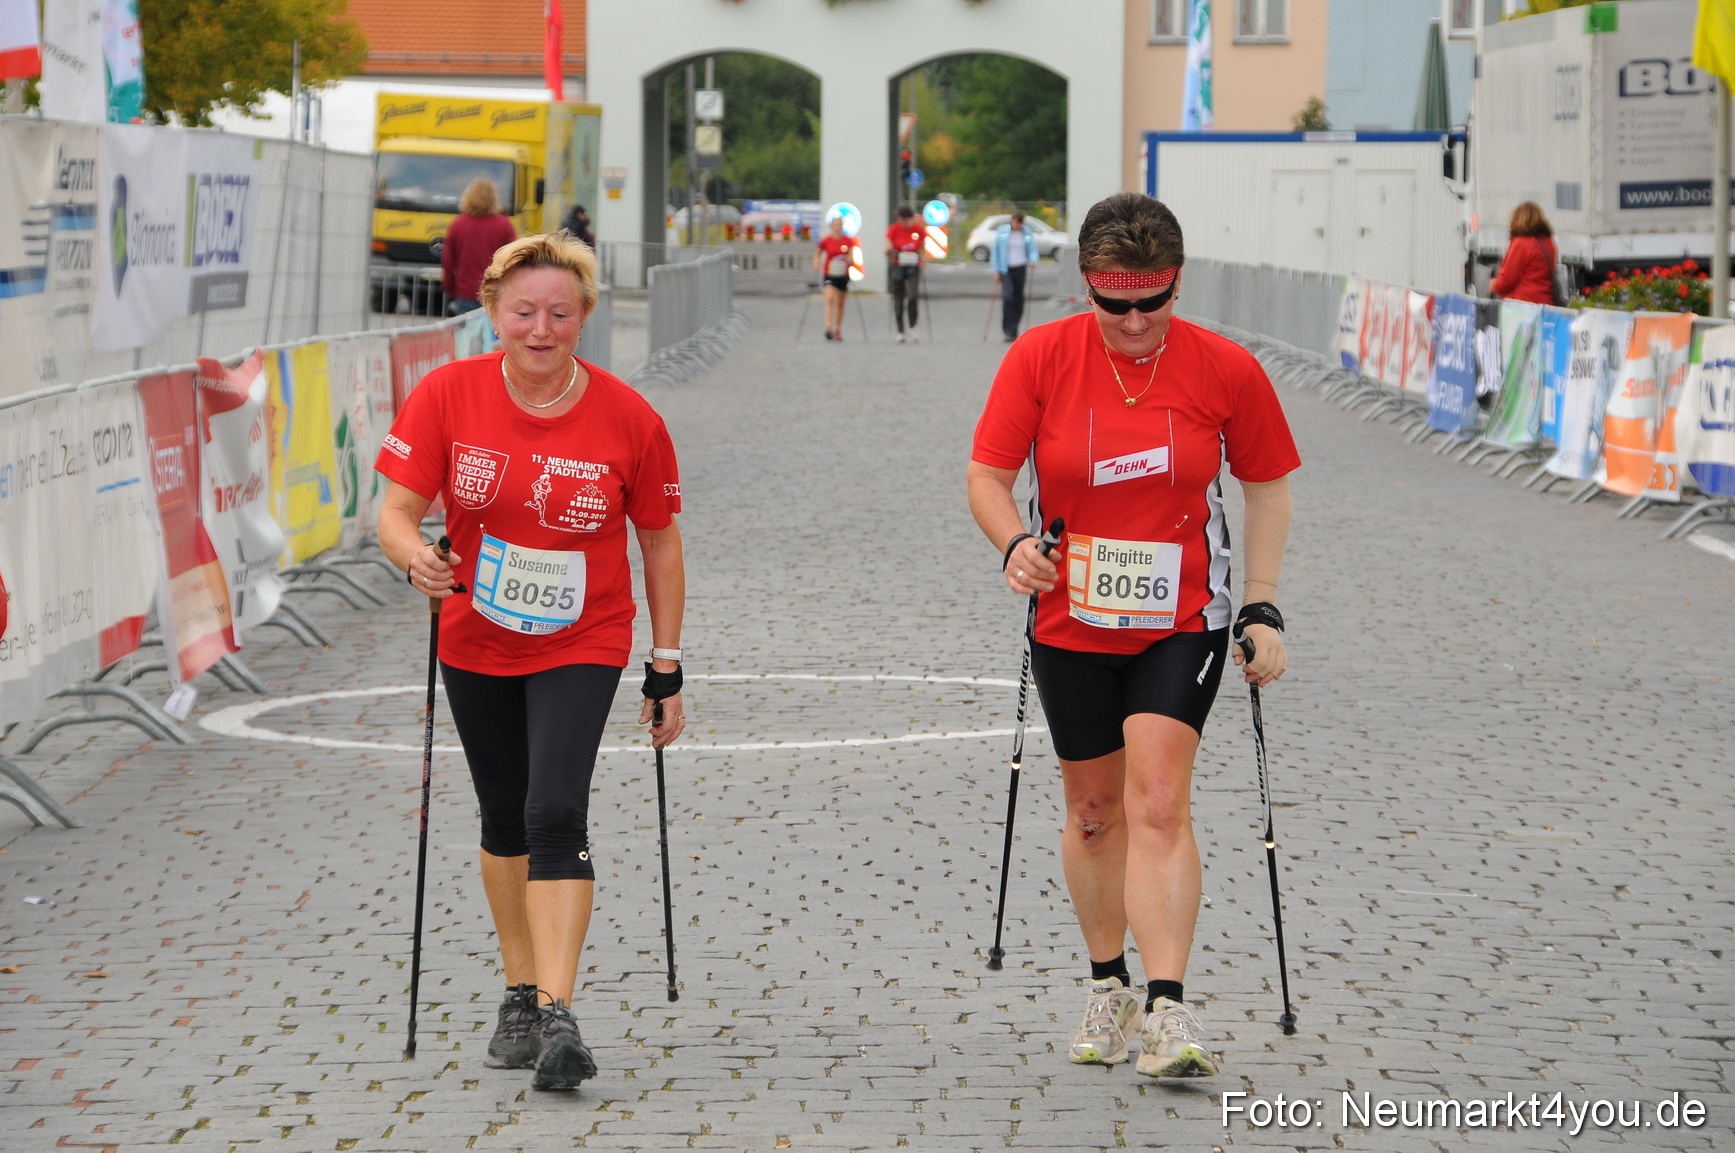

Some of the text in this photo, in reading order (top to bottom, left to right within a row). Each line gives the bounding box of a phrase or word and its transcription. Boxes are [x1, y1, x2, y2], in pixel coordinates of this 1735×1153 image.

[1619, 58, 1716, 97] BO
[1626, 186, 1712, 204] www.boc
[457, 453, 497, 470] IMMER
[531, 454, 610, 475] 11. NEUMARKTER
[1114, 458, 1149, 476] DEHN
[456, 462, 496, 480] WIEDER
[543, 465, 601, 481] STADTLAUF
[455, 472, 490, 493] NEU
[454, 486, 487, 503] MARKT
[566, 509, 607, 520] 19.09.2010
[508, 551, 569, 576] Susanne
[1097, 544, 1153, 568] Brigitte
[503, 578, 576, 610] 8055
[1096, 573, 1169, 601] 8056
[1131, 615, 1174, 624] PFLEIDERER
